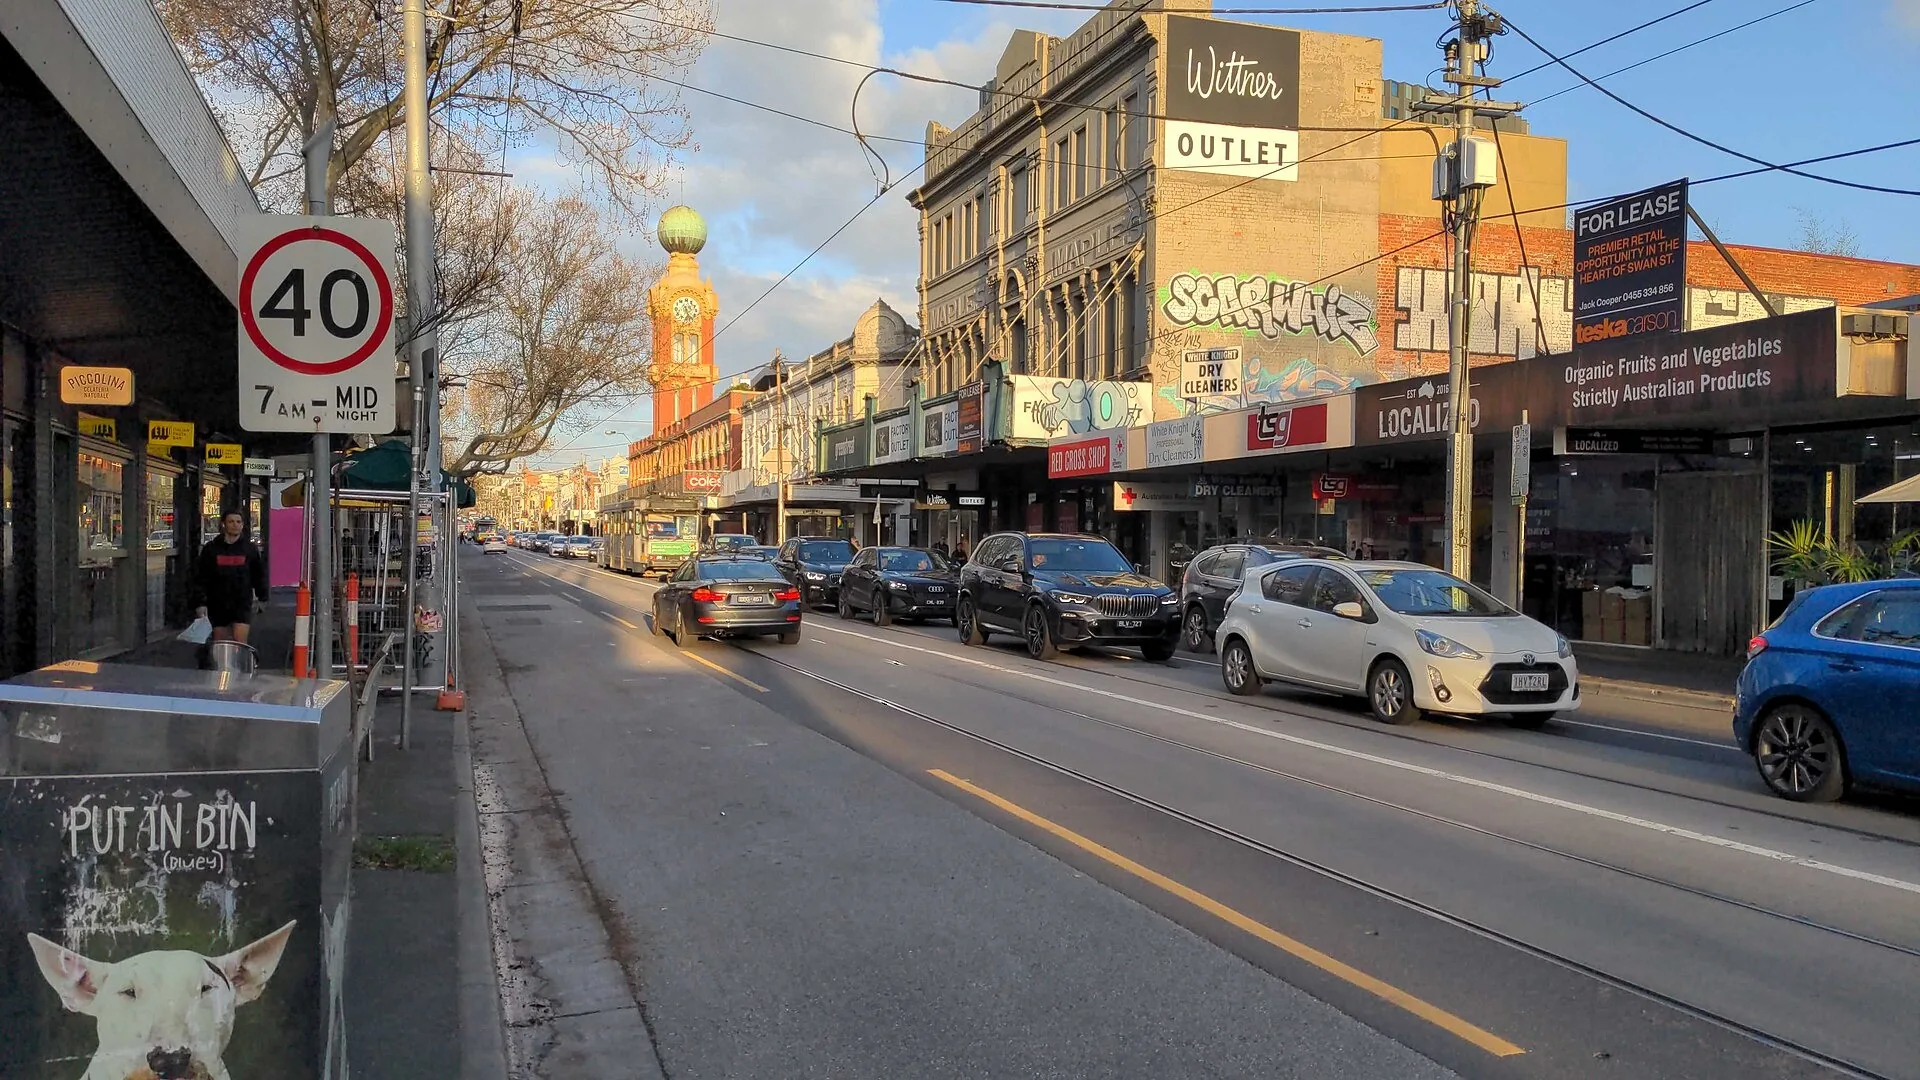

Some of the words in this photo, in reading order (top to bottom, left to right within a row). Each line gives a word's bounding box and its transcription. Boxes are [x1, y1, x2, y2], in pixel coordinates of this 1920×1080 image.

[1187, 46, 1283, 100] Wittner
[1178, 133, 1287, 166] OUTLET
[1579, 210, 1614, 236] FOR
[1618, 191, 1680, 226] LEASE
[1051, 216, 1144, 277] MAPLES
[1576, 247, 1644, 273] OPPORTUNITY
[1645, 245, 1656, 256] IN
[1658, 238, 1680, 252] THE
[1588, 238, 1631, 257] PREMIER
[1631, 229, 1666, 248] RETAIL
[1580, 267, 1612, 285] HEART
[1612, 265, 1626, 277] OF
[1627, 257, 1658, 273] SWAN
[1659, 252, 1675, 266] ST.
[259, 268, 369, 339] 40
[928, 287, 985, 329] MAPLES
[1579, 298, 1596, 311] Jack
[1596, 294, 1623, 309] Cooper
[1623, 289, 1642, 301] 0455
[1642, 286, 1658, 297] 334
[1658, 283, 1674, 295] 856
[1575, 310, 1678, 344] teskacarson
[1187, 353, 1210, 362] WHITE
[1211, 350, 1238, 360] KNIGHT
[1565, 362, 1614, 385] Organic
[1618, 354, 1656, 376] Fruits
[1661, 349, 1687, 370] and
[1693, 338, 1782, 368] Vegetables
[67, 373, 126, 391] PICCOLINA
[1199, 364, 1223, 377] DRY
[336, 385, 378, 409] MID
[1185, 378, 1238, 394] CLEANERS
[1406, 389, 1417, 399] EST
[1436, 384, 1449, 394] 2016
[1572, 388, 1619, 408] Strictly
[1623, 377, 1695, 402] Australian
[1700, 369, 1771, 393] Products
[336, 411, 378, 421] NIGHT
[1151, 425, 1168, 437] White
[1168, 423, 1189, 437] Knight
[1257, 403, 1292, 447] tsg
[1379, 398, 1480, 438] LOCALIZD
[891, 439, 909, 452] OUTLET
[1051, 452, 1062, 472] RED
[1065, 448, 1087, 471] CROSS
[1089, 445, 1107, 468] SHOP
[1149, 452, 1161, 466] Dry
[1162, 449, 1193, 462] Cleaners
[1575, 440, 1619, 451] LOCALIZED
[246, 462, 271, 471] FISHBOWL
[1195, 484, 1218, 496] DRY
[1222, 485, 1282, 496] CLEANERS
[1320, 474, 1348, 497] tsg
[69, 804, 135, 857] PUT
[143, 802, 182, 851] IN
[196, 800, 256, 851] BIN
